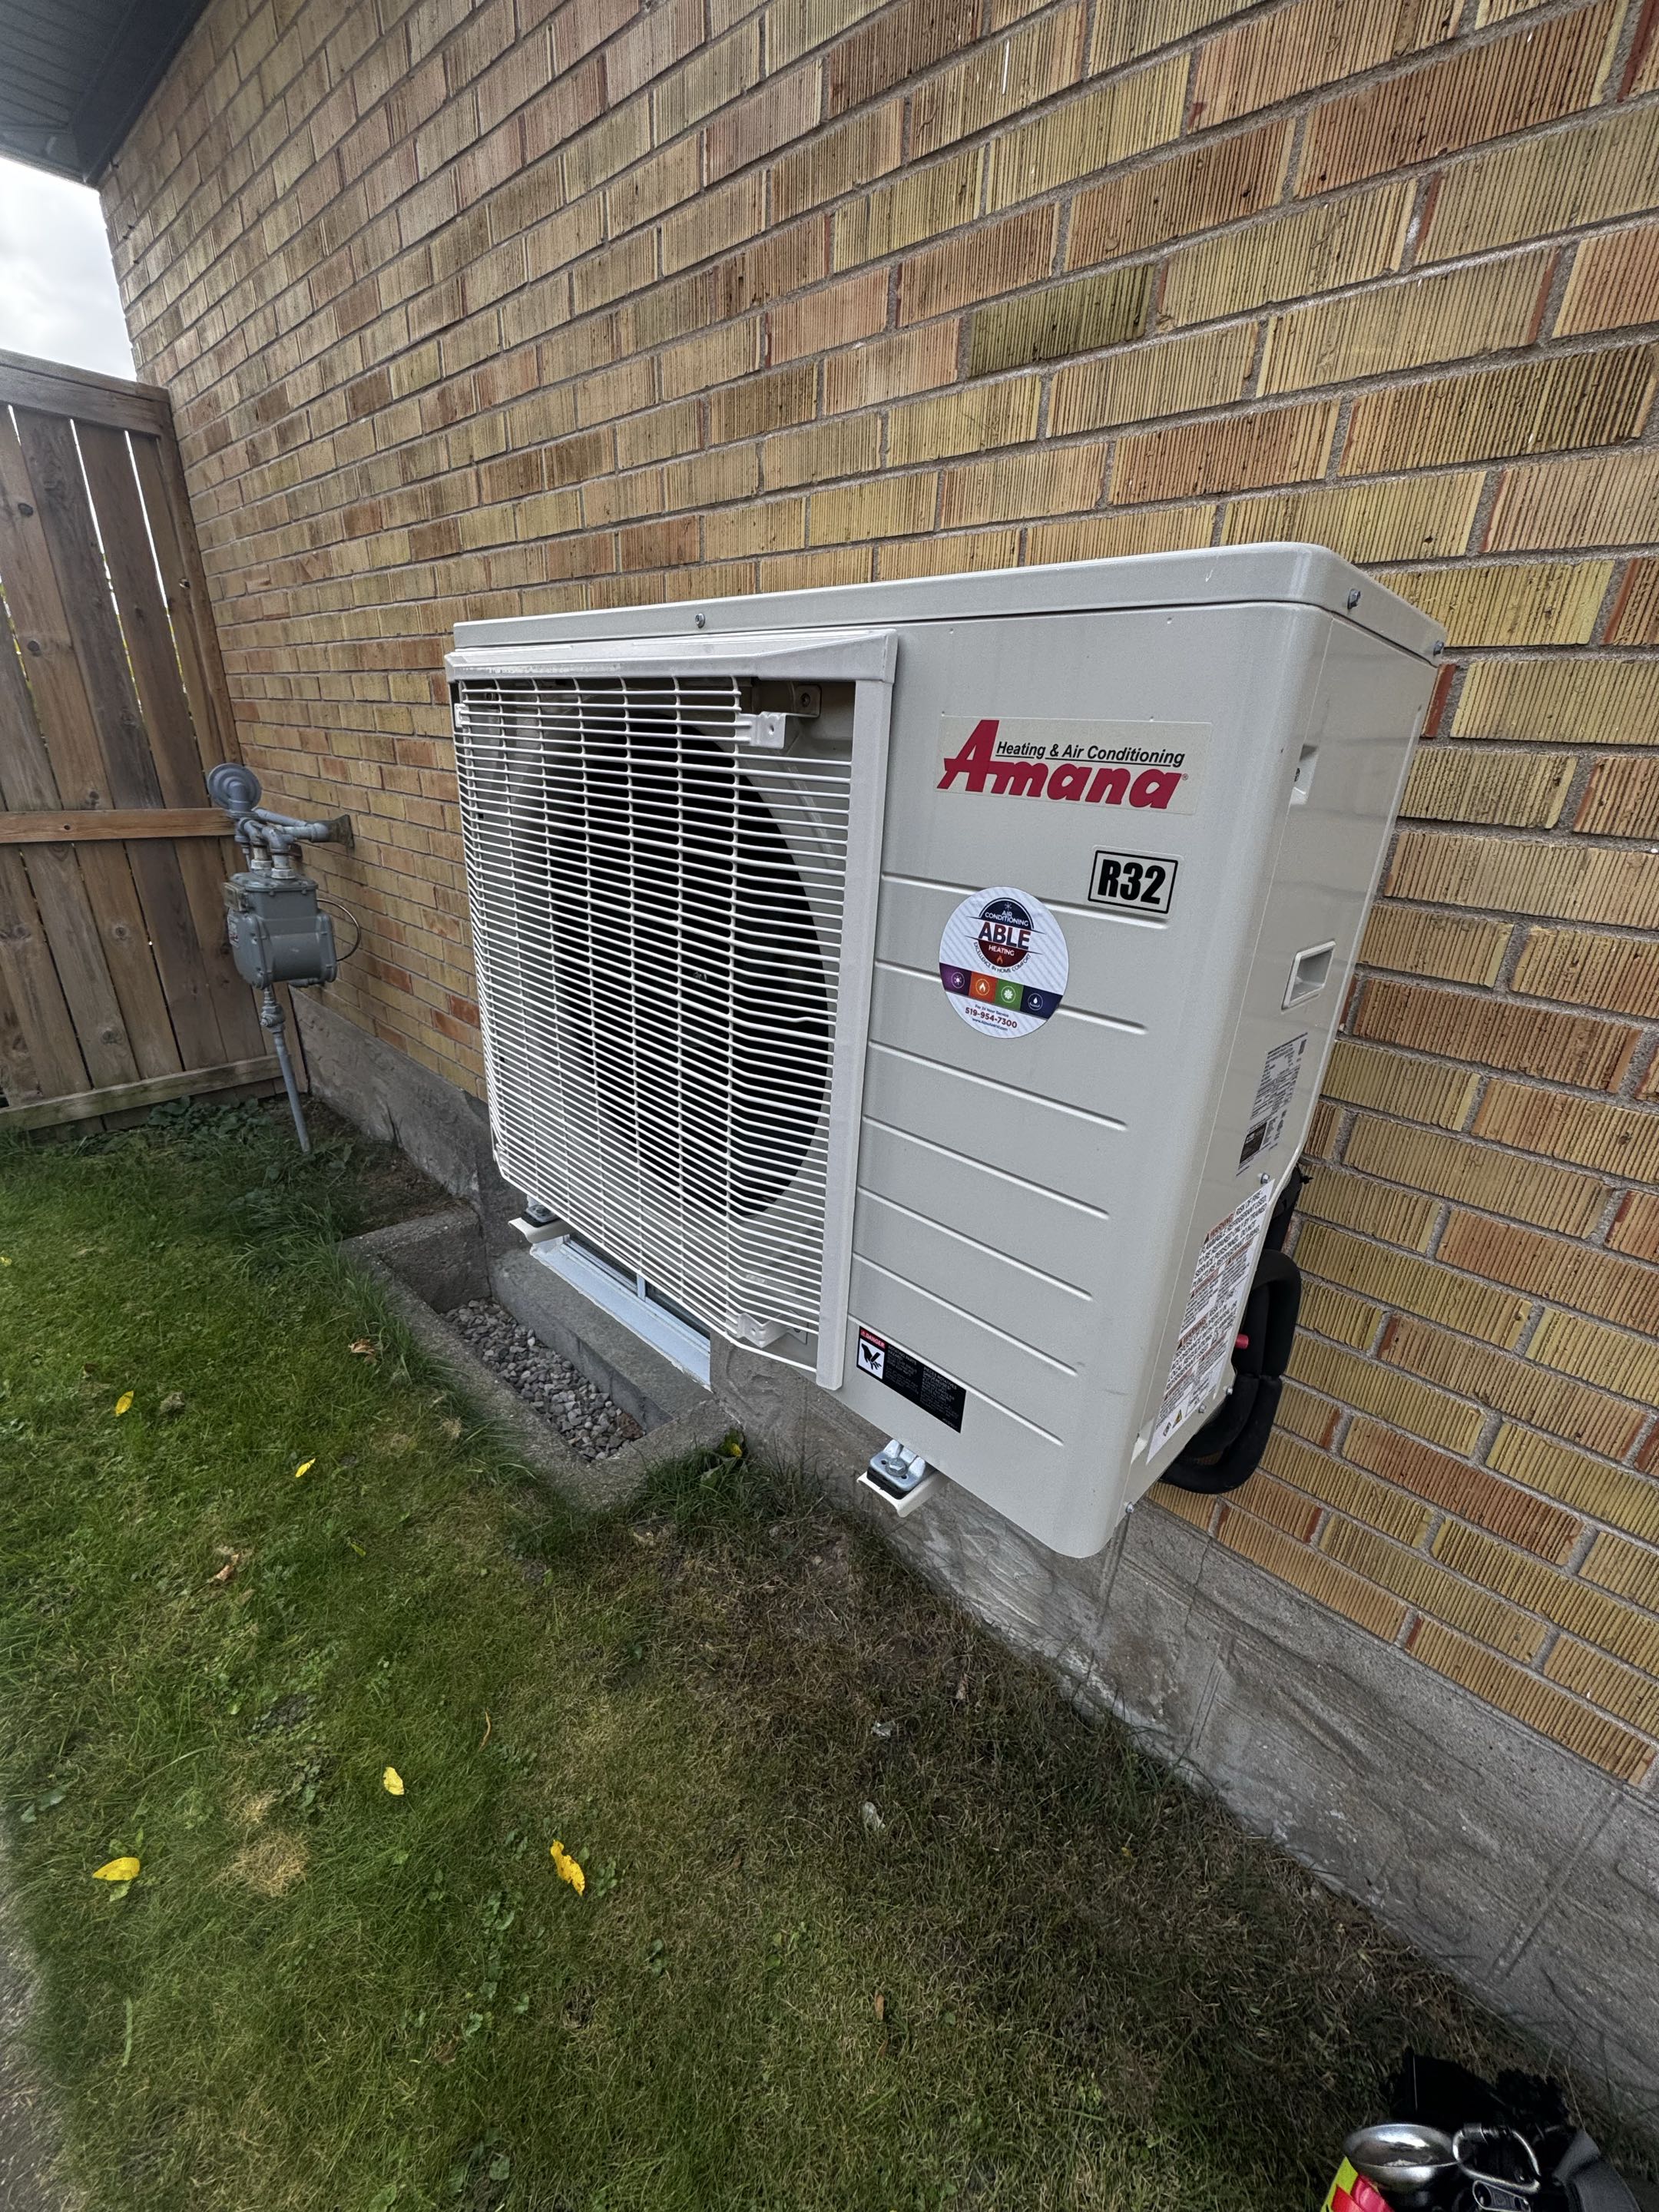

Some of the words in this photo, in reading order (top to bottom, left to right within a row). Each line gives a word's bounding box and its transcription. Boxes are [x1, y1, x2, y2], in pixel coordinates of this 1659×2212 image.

[995, 740, 1047, 759] Heating
[1049, 745, 1060, 757] &
[1062, 744, 1085, 758] Air
[1088, 745, 1185, 767] Conditioning
[936, 719, 1182, 810] Amana
[1097, 859, 1167, 905] R32
[985, 912, 1029, 927] CONDITIONING
[978, 921, 1031, 950] ABLE
[988, 944, 1015, 956] HEATING
[1012, 953, 1031, 972] COMFORT
[965, 1007, 1018, 1028] 519-954-7300
[866, 1333, 886, 1349] DANGER
